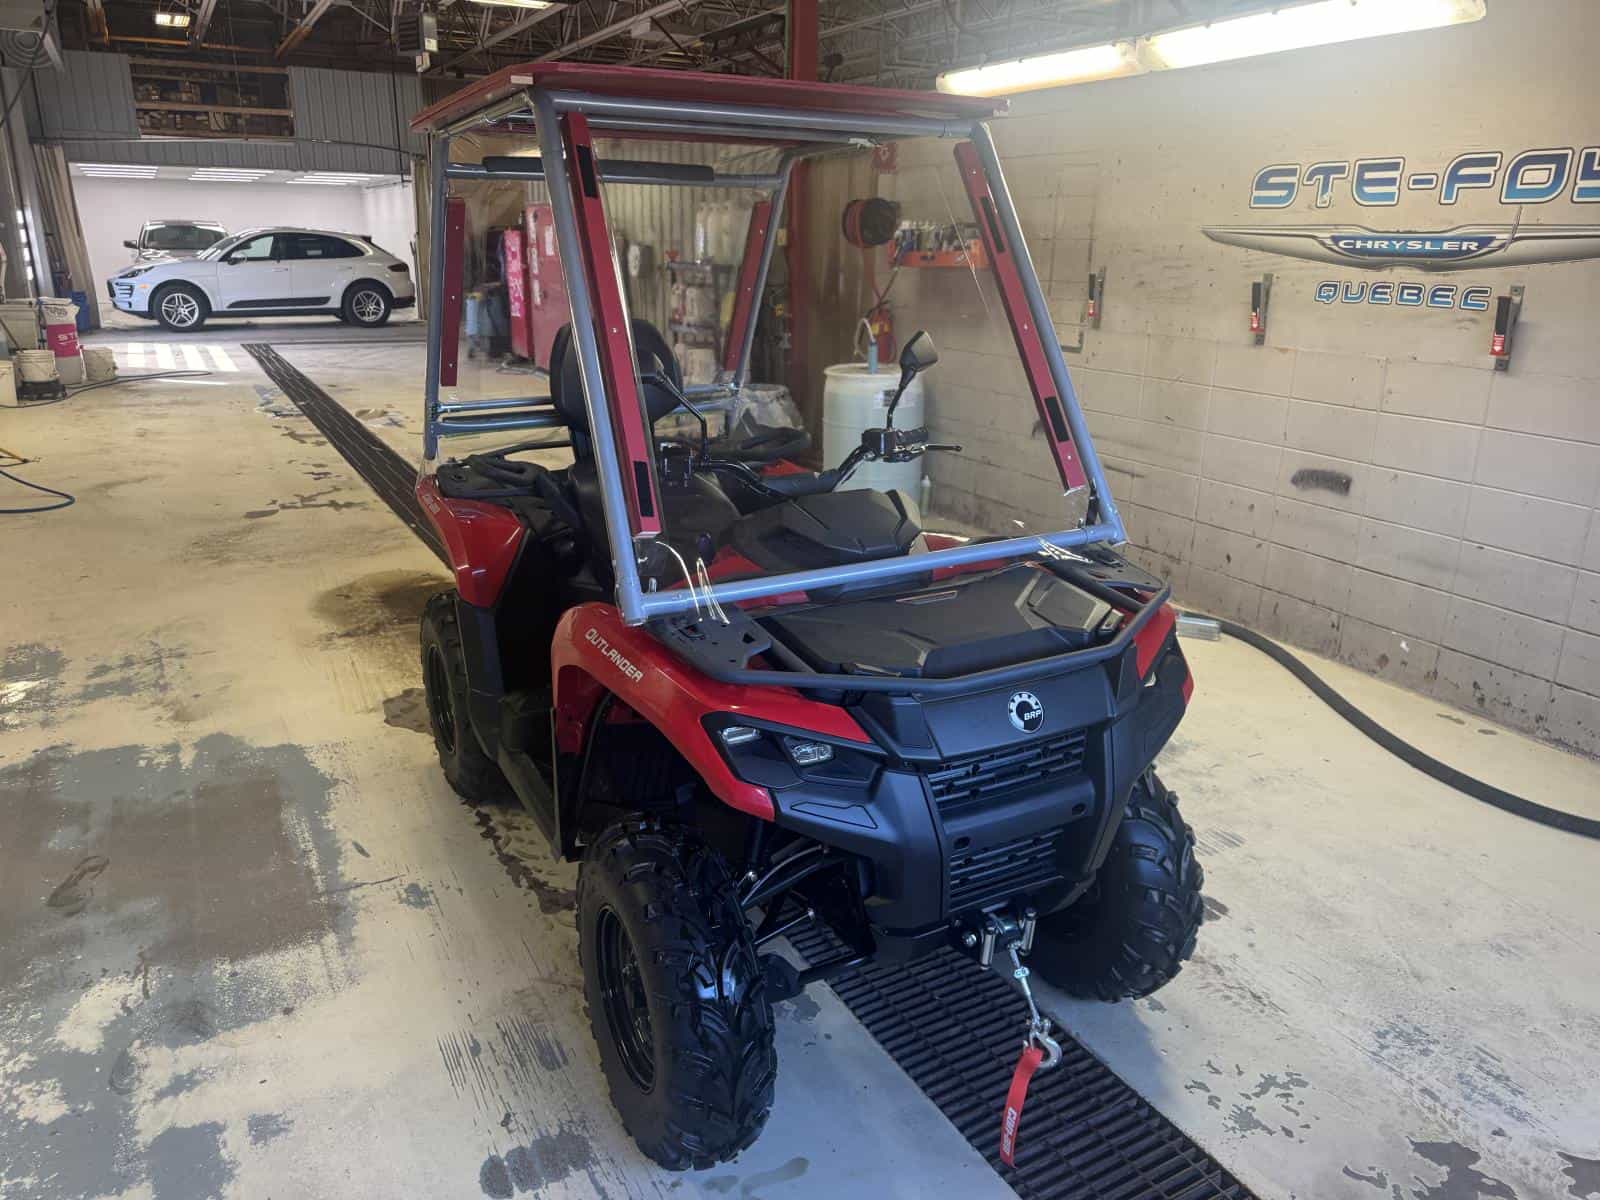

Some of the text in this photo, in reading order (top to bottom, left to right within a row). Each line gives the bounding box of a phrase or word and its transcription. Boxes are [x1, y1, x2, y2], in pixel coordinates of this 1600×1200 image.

[1338, 238, 1481, 252] CHRYSLER
[1314, 281, 1492, 311] QUEBEC
[584, 628, 644, 682] OUTLANDER
[1024, 709, 1042, 720] BRP
